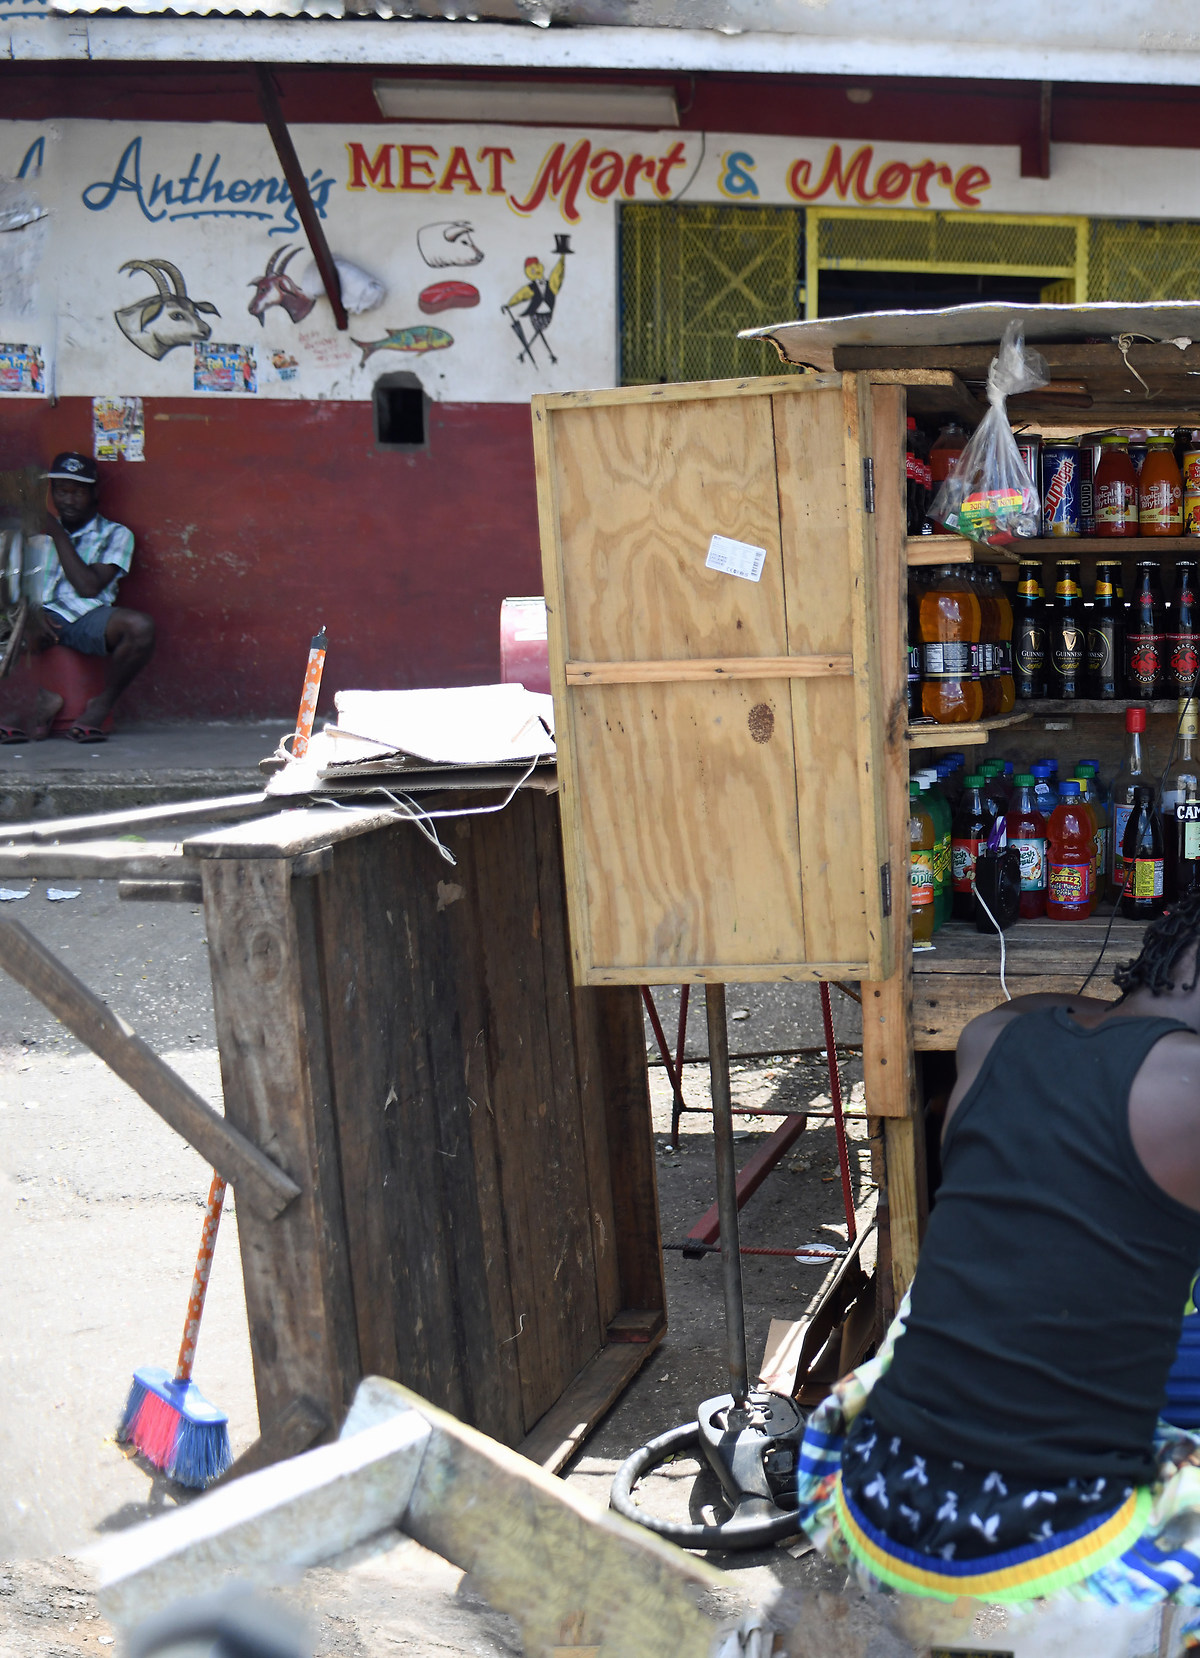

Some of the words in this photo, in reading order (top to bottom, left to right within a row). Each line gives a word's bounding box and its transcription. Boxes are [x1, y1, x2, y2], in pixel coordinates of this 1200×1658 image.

[345, 141, 517, 196] MEAT
[508, 138, 687, 224] Mart
[717, 150, 760, 200] &
[786, 143, 992, 210] More
